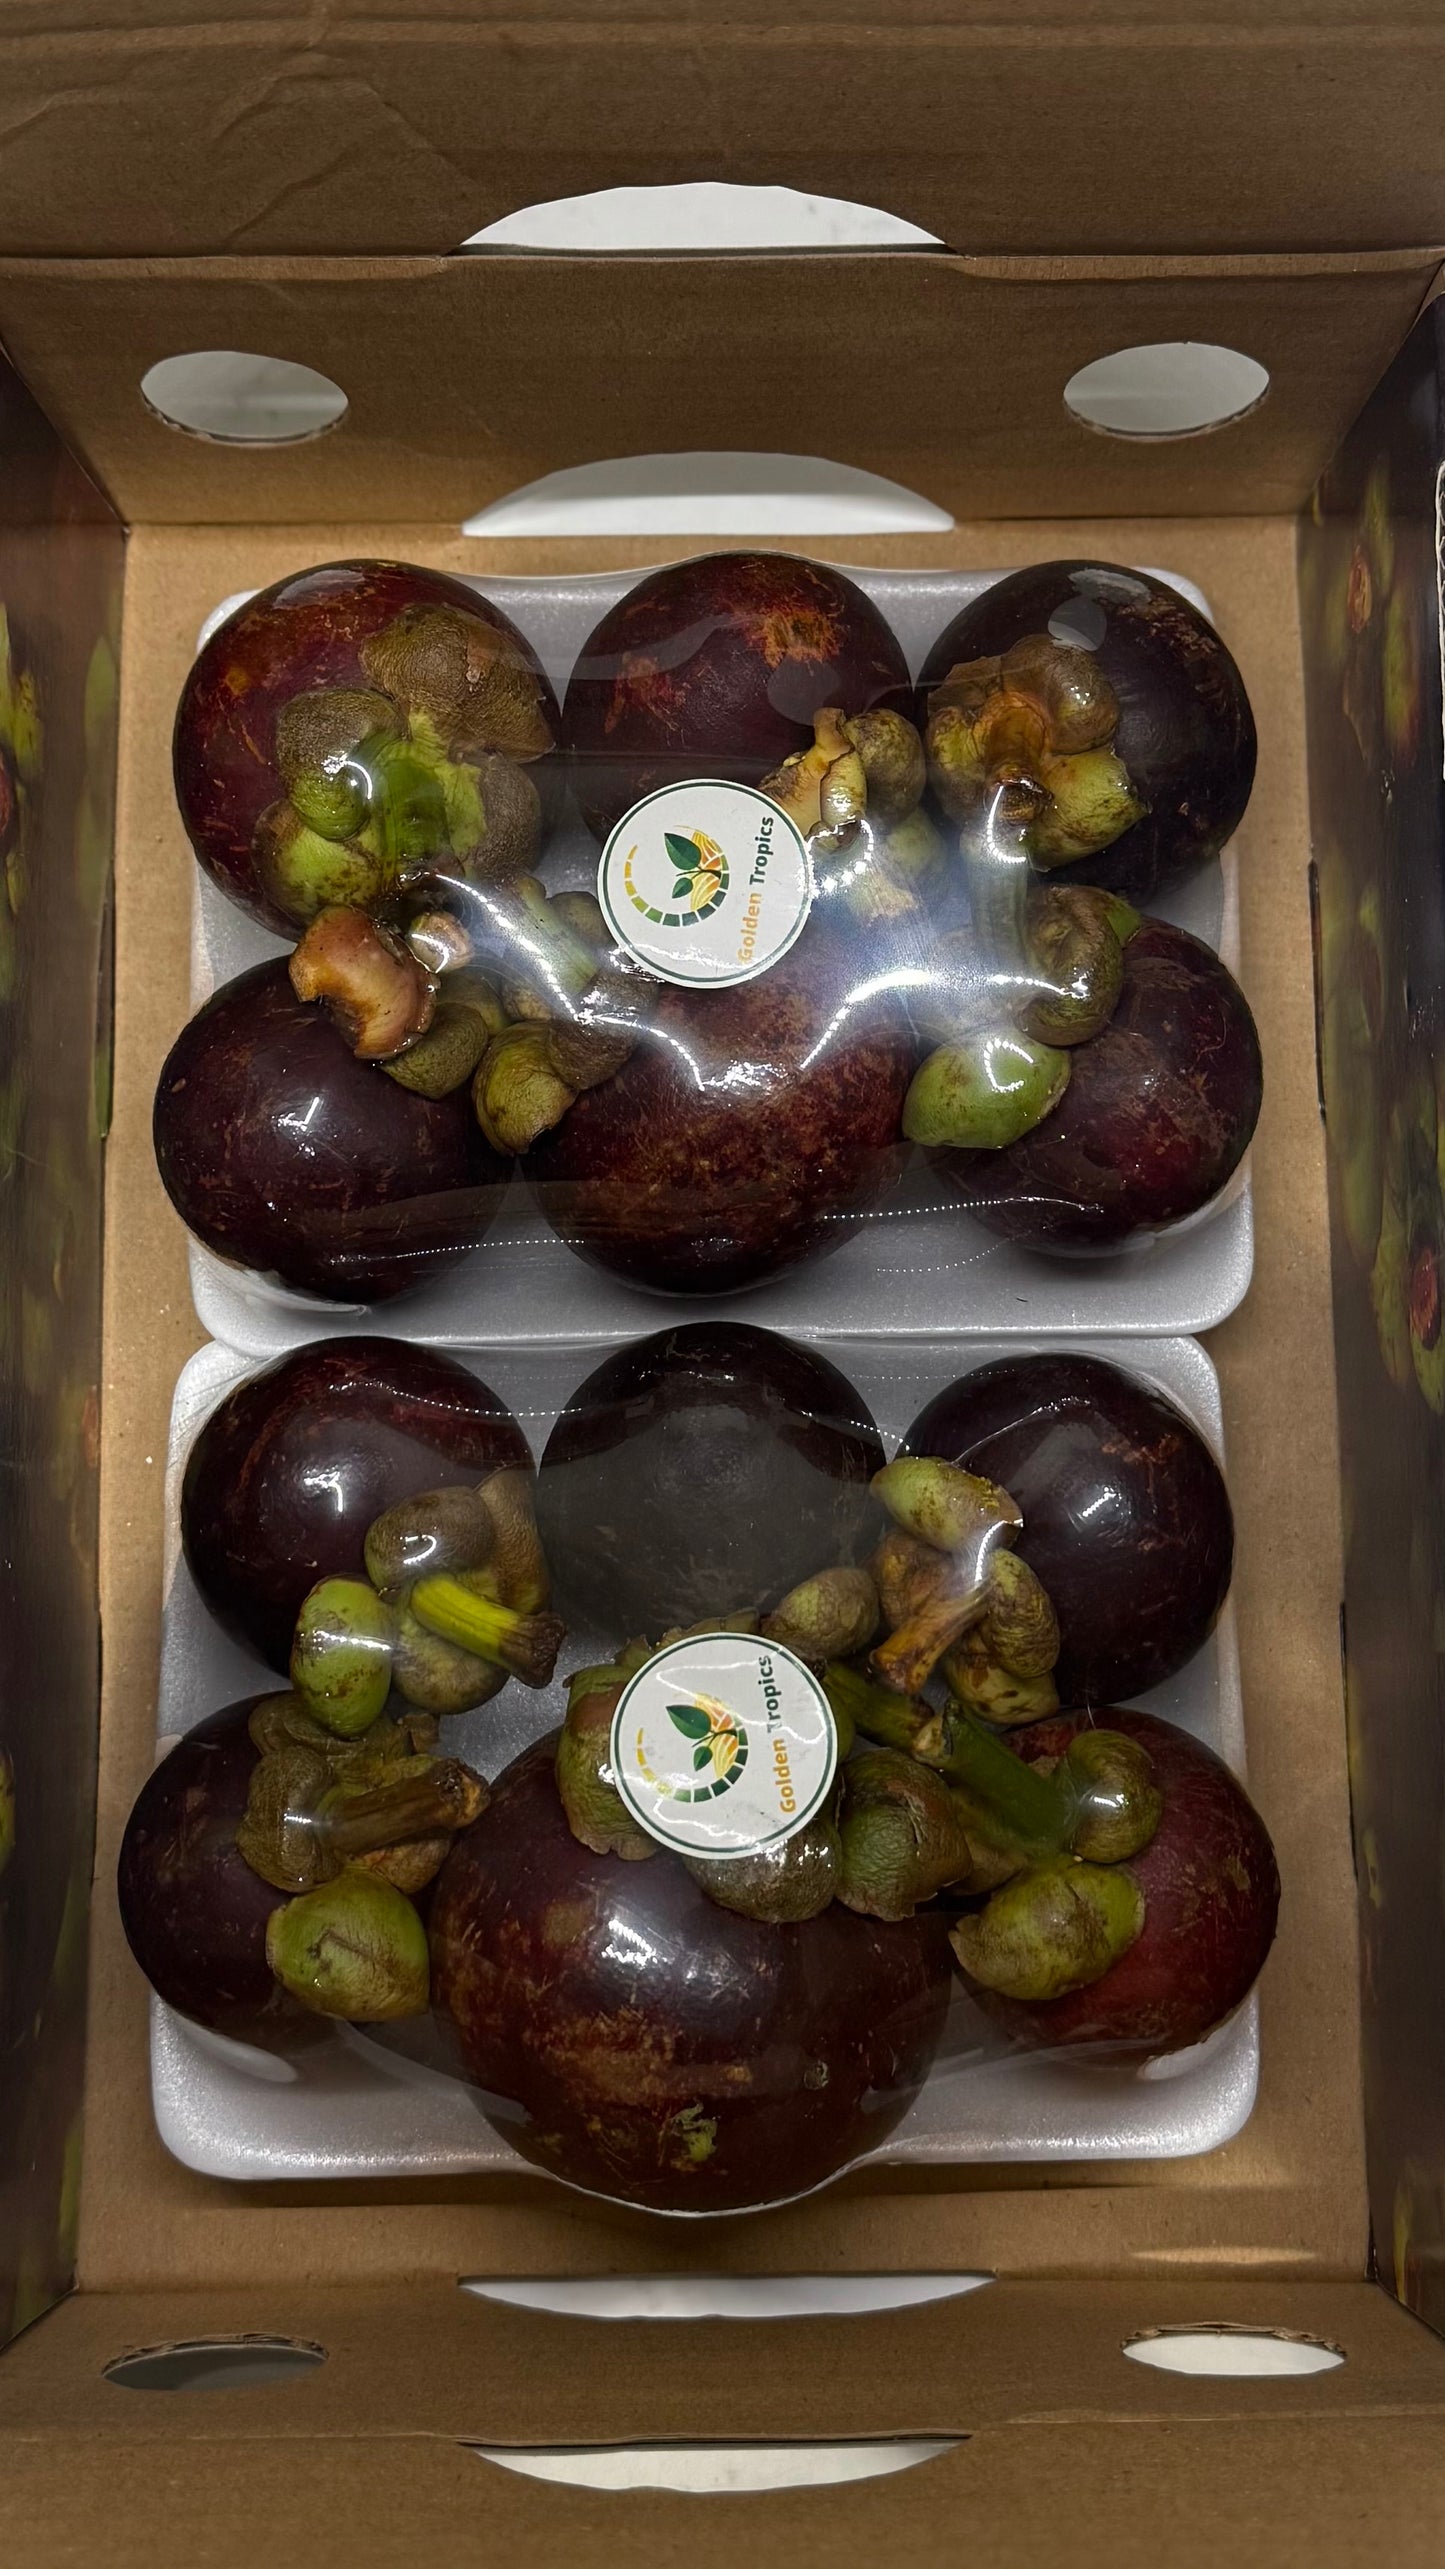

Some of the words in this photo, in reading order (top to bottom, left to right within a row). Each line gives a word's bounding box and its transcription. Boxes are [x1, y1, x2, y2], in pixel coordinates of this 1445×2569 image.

[749, 816, 774, 886] Tropics
[737, 892, 762, 964] Golden
[772, 1738, 796, 1813] Golden
